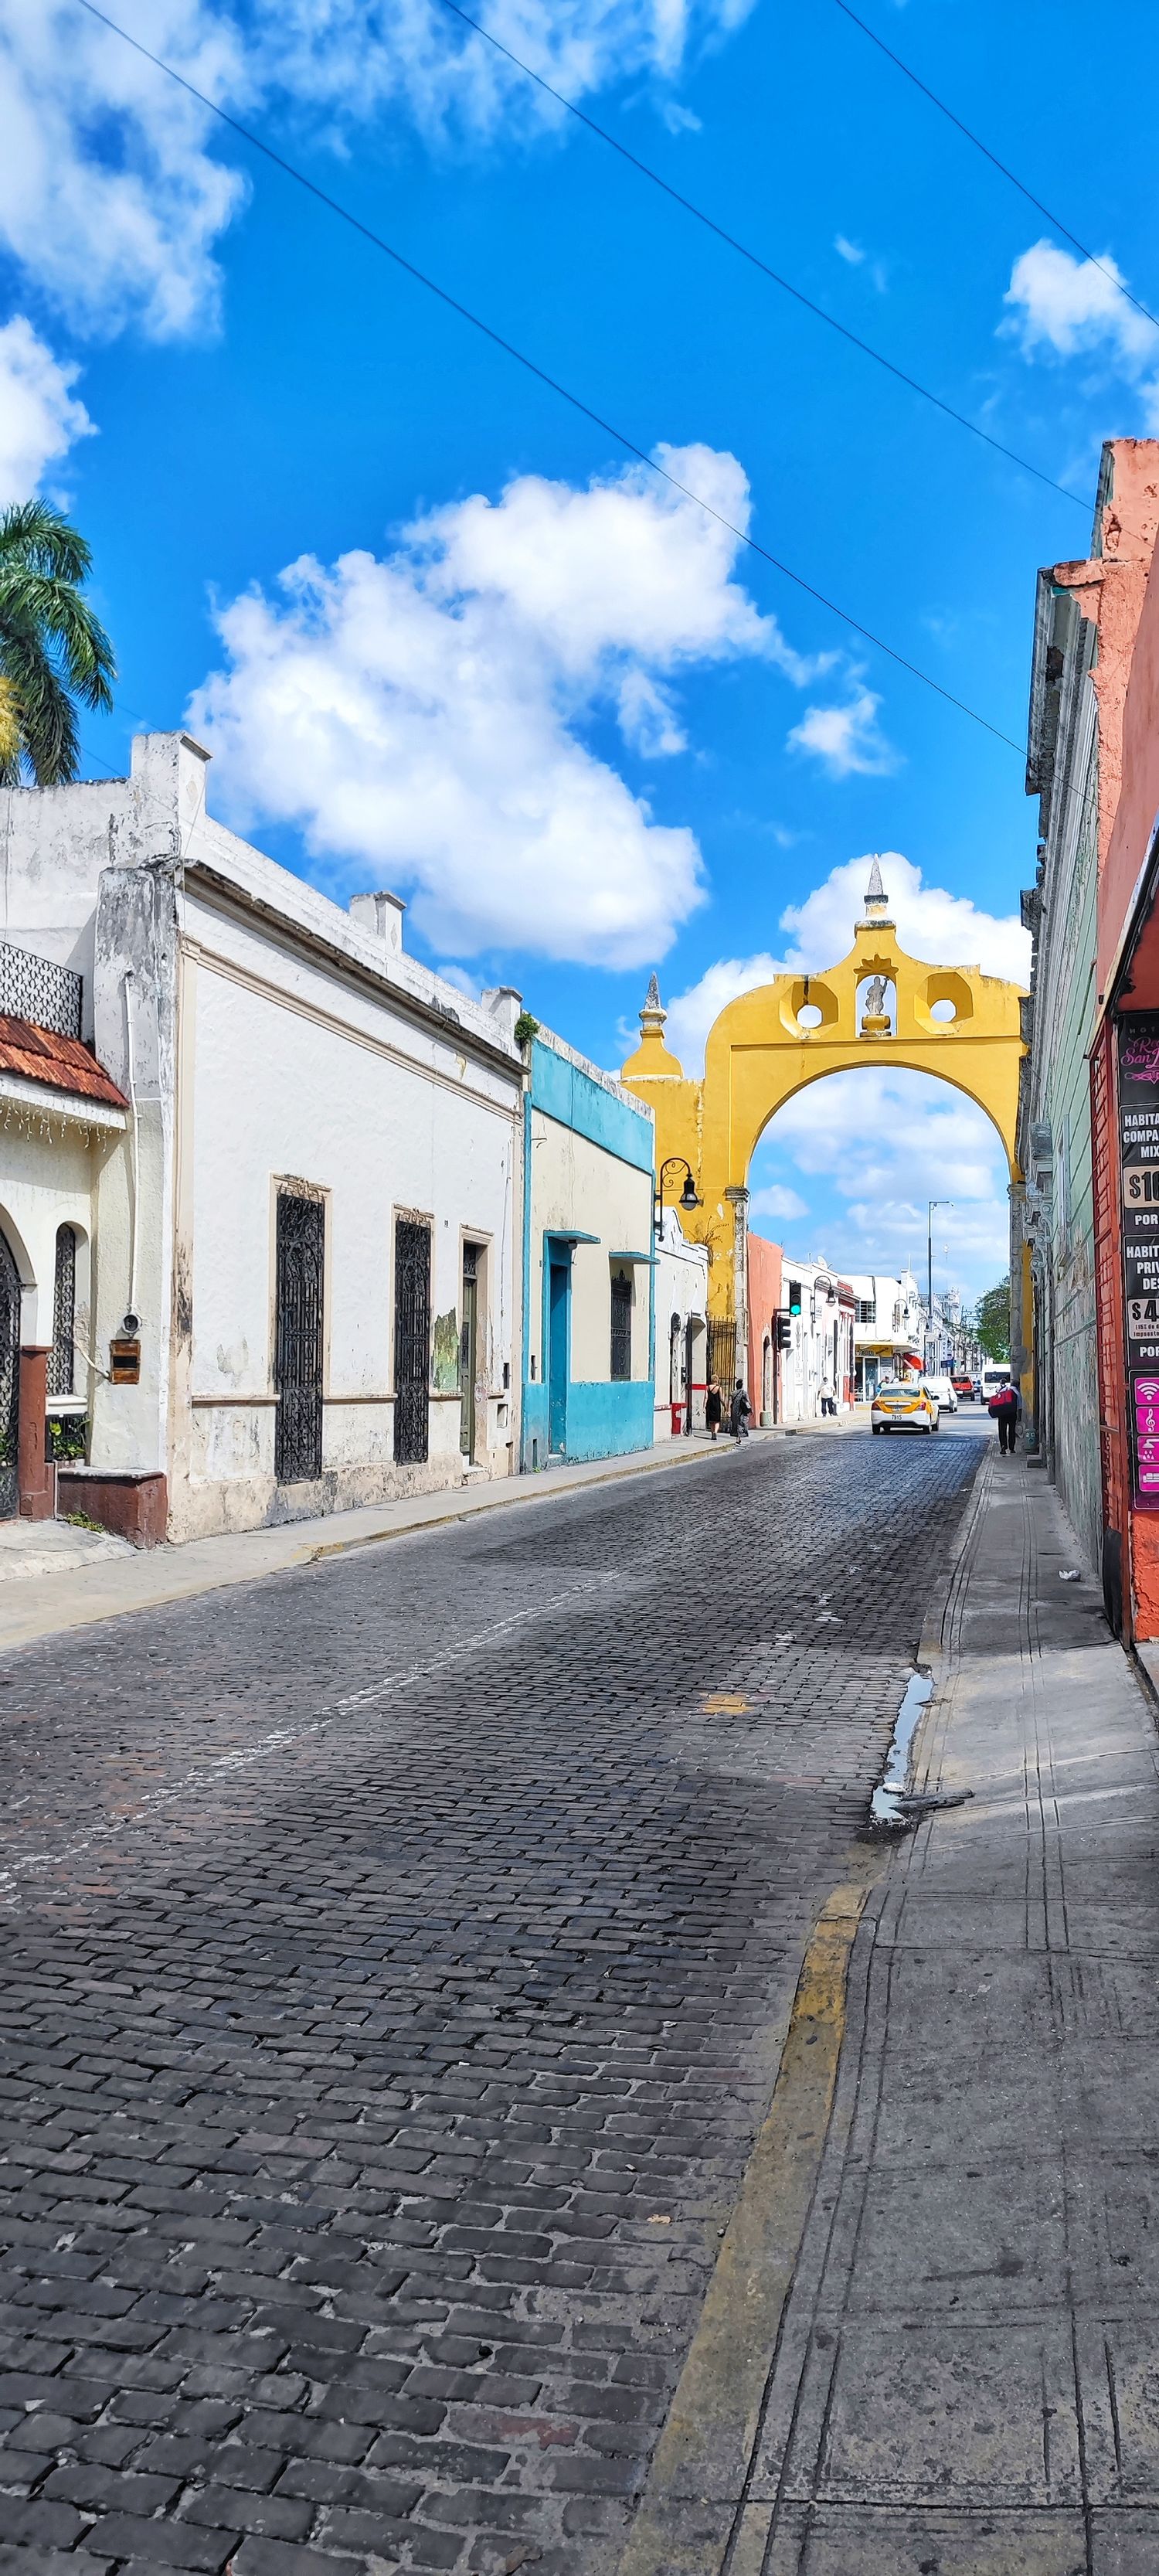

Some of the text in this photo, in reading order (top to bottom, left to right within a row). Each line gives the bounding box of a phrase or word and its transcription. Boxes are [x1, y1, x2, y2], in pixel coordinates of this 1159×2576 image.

[1120, 1047, 1150, 1066] San
[1123, 1129, 1159, 1143] COMPA
[1140, 1145, 1159, 1158] MIX
[1134, 1214, 1159, 1226] POR
[1126, 1245, 1159, 1258] HABIT
[1142, 1278, 1159, 1290] DE
